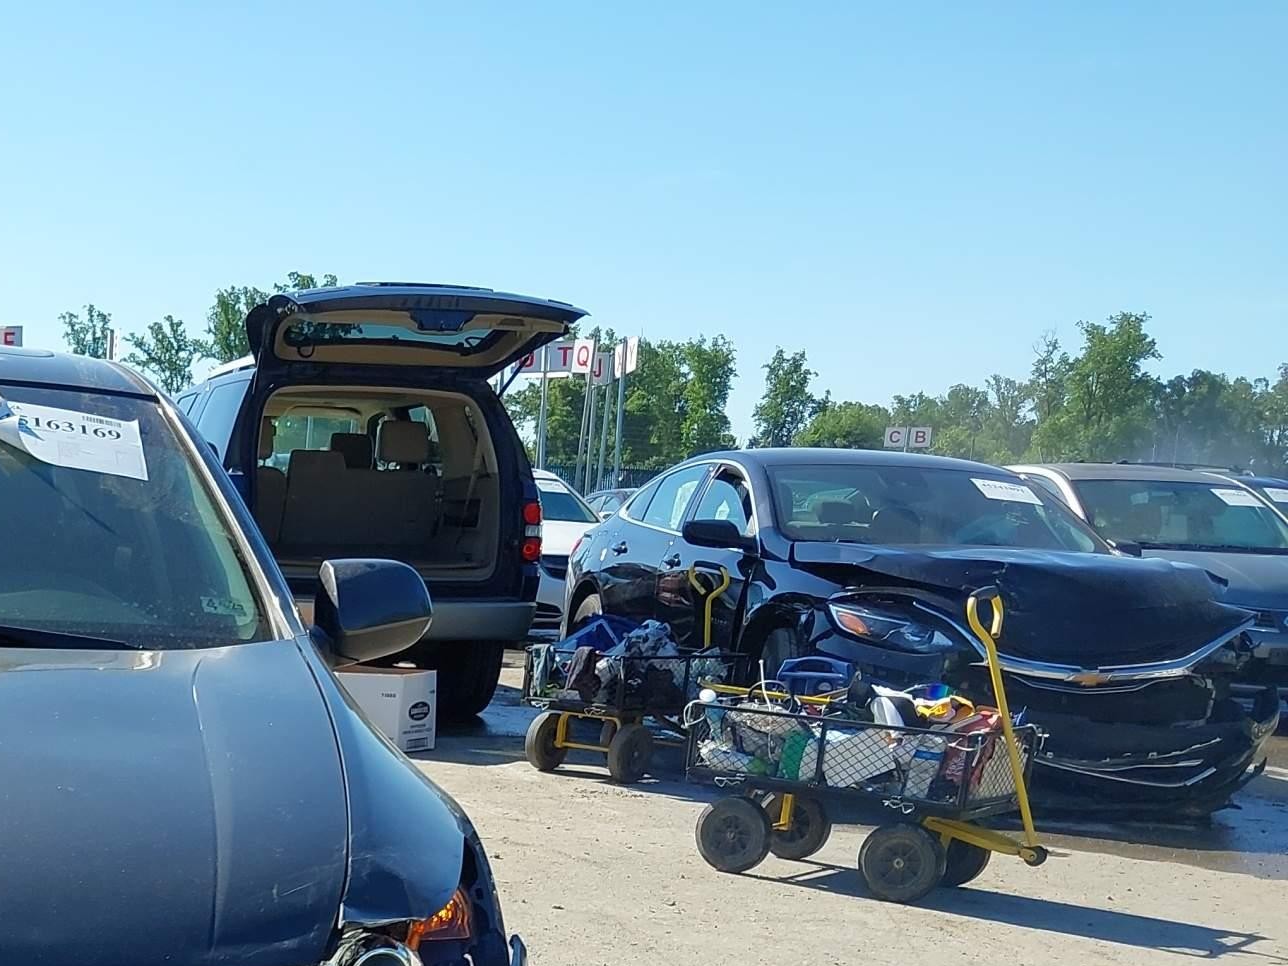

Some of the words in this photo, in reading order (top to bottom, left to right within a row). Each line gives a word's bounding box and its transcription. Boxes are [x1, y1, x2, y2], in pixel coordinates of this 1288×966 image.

[557, 346, 573, 367] T
[577, 345, 590, 367] Q
[889, 430, 901, 443] C
[915, 430, 926, 443] B
